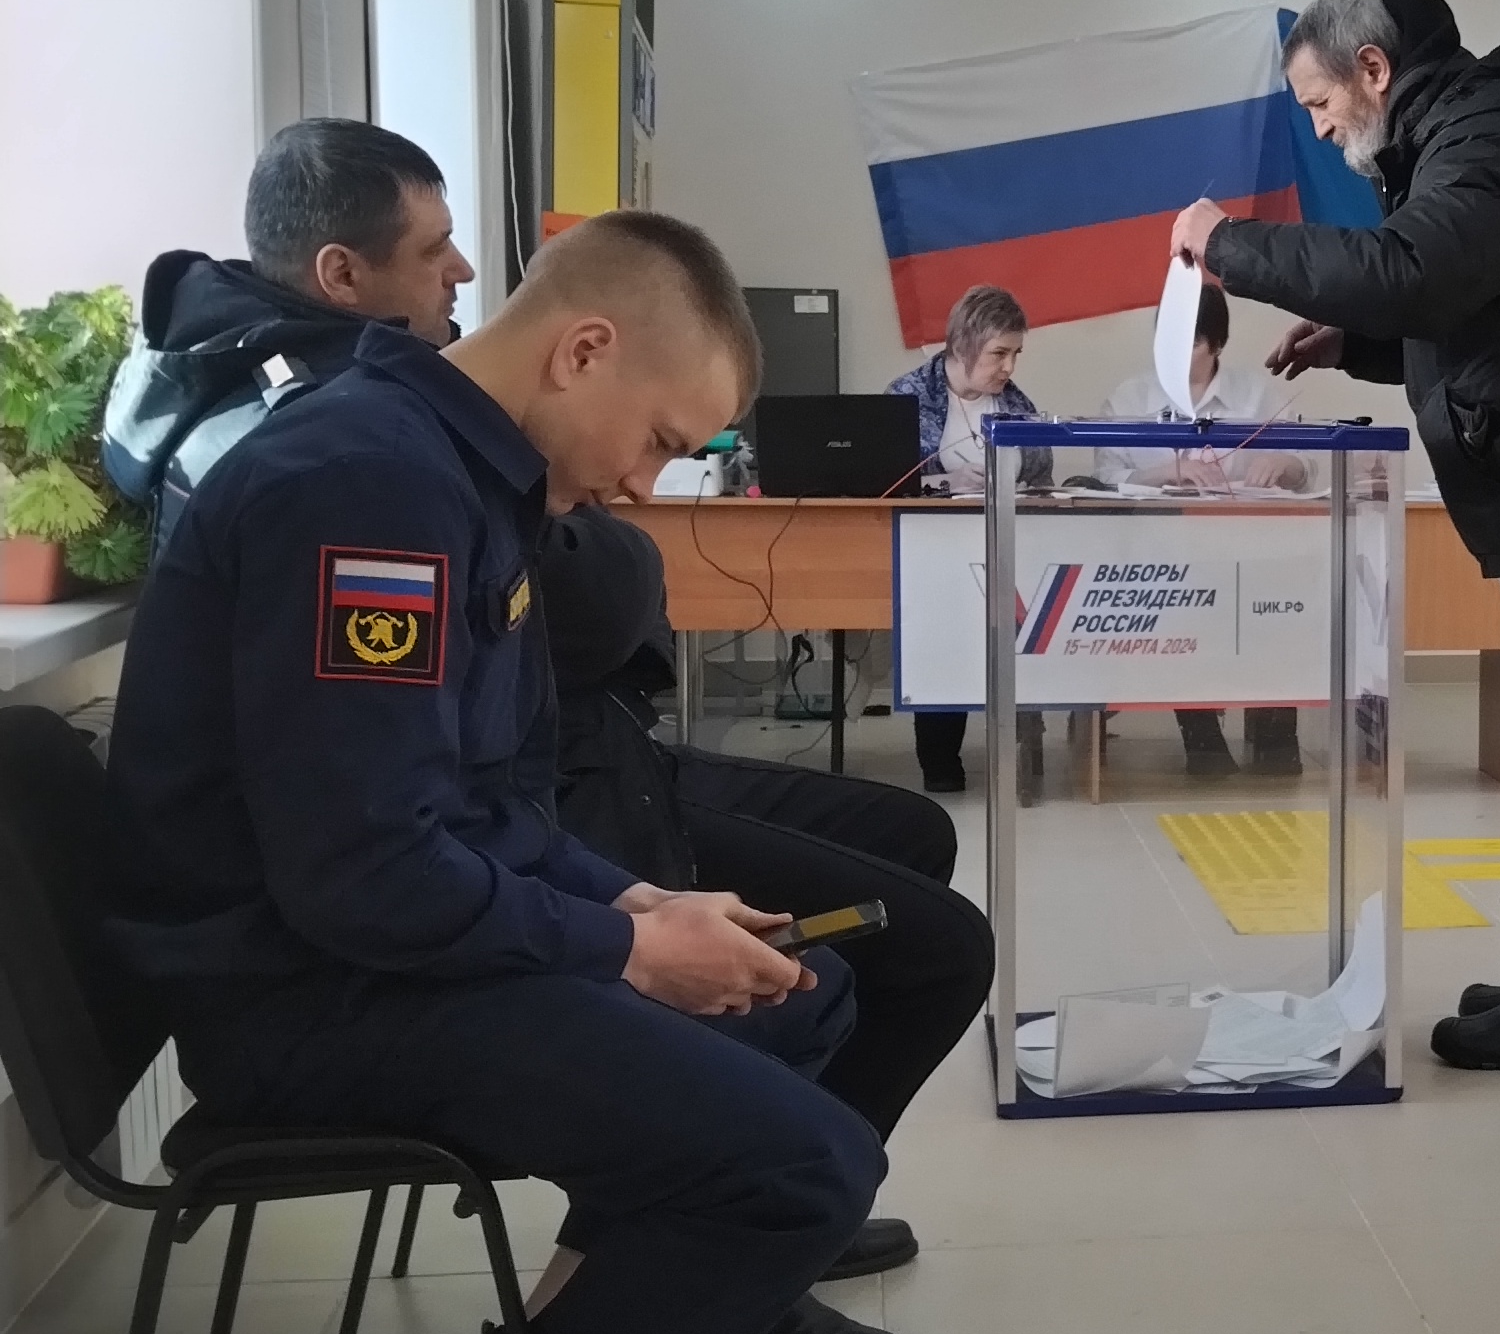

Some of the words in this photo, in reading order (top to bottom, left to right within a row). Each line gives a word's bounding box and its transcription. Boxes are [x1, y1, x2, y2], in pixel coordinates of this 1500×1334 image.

[1093, 564, 1190, 583] ВЫБОРЫ
[1082, 589, 1217, 610] ПРЕЗИДЕНТА
[1252, 600, 1304, 616] ЦИК.РФ
[1071, 614, 1159, 633] РОССИИ
[1106, 638, 1159, 655] МАРТА
[1160, 638, 1198, 654] 2024
